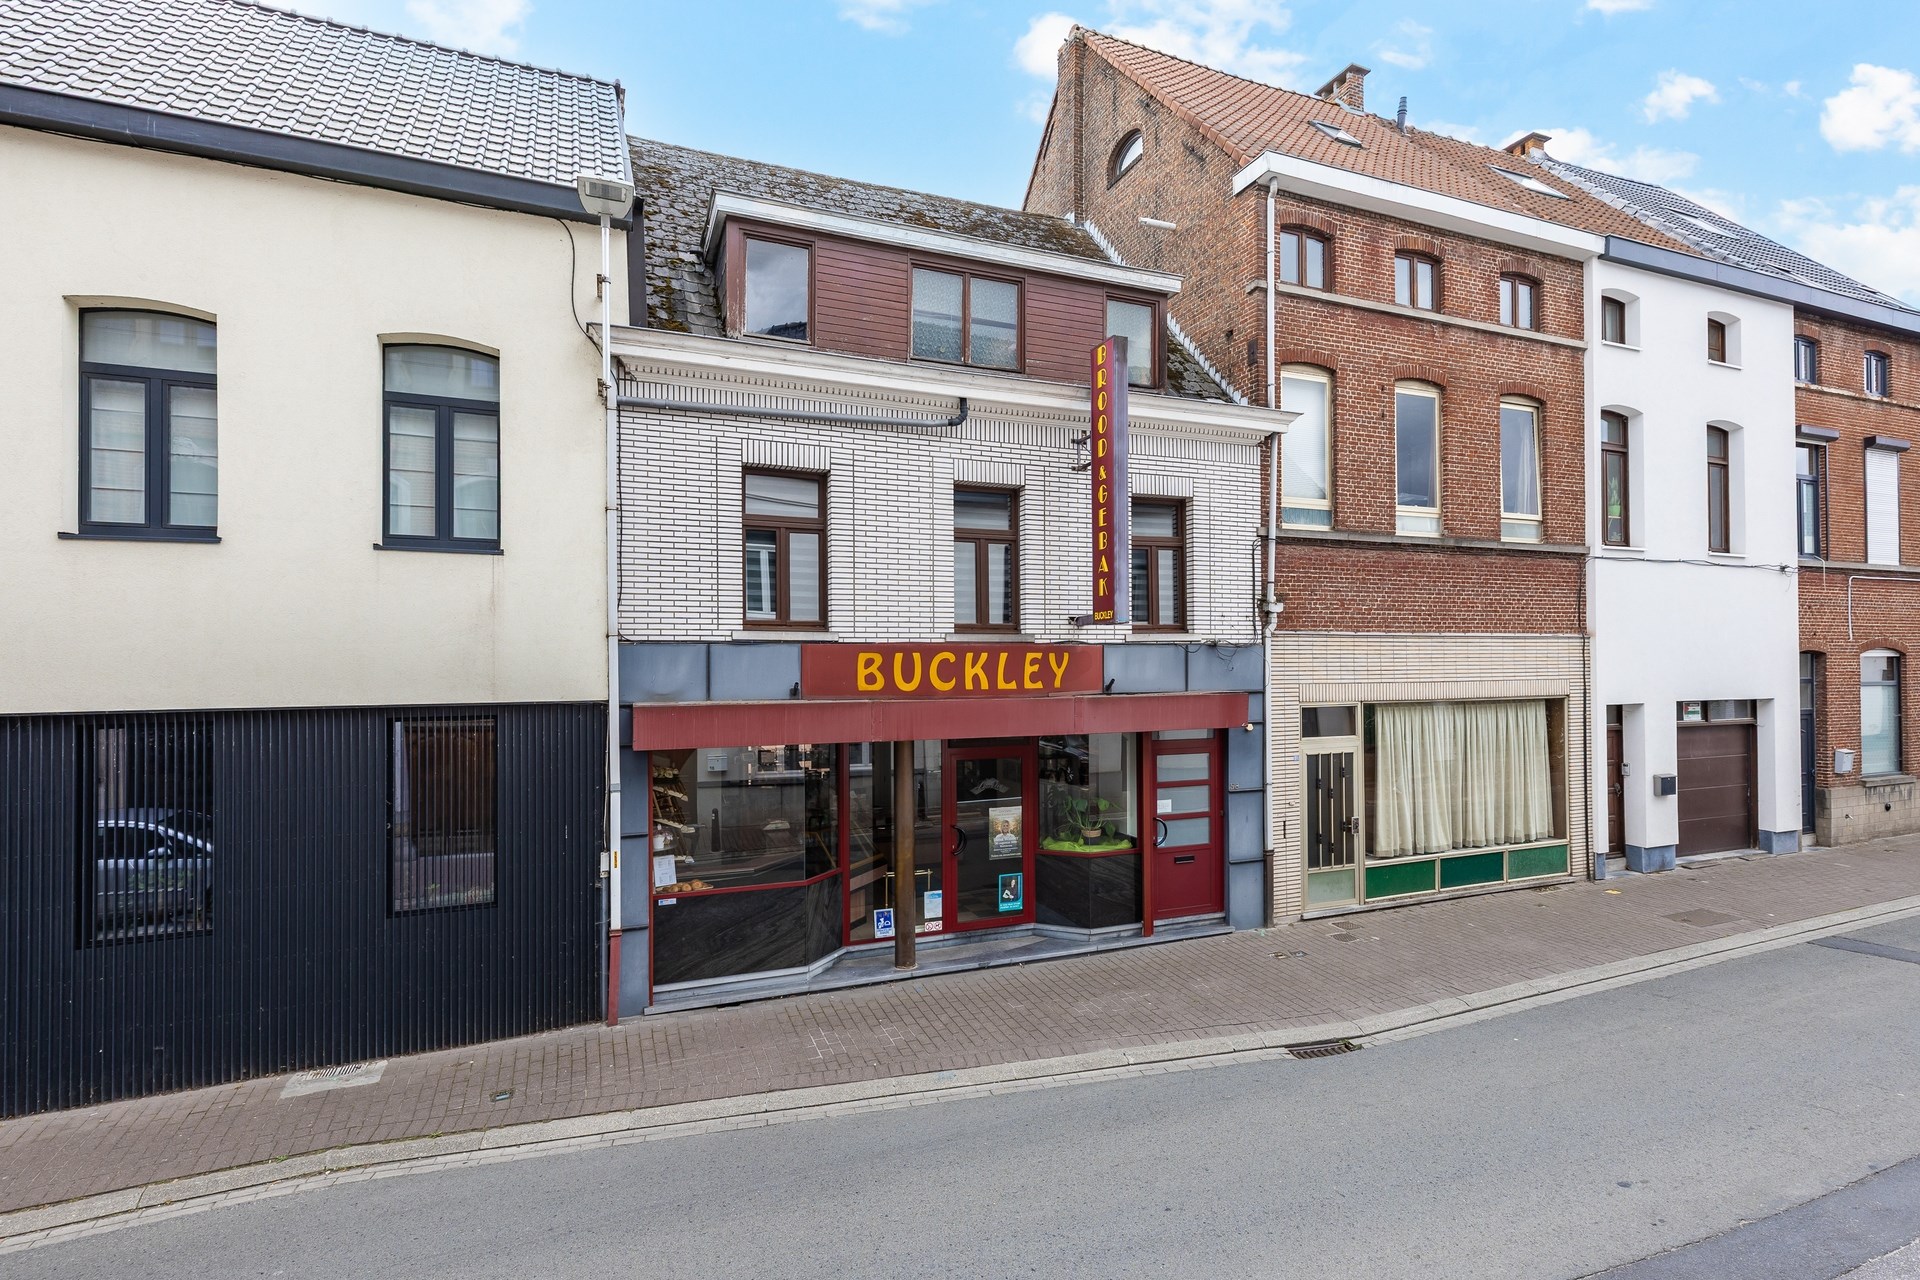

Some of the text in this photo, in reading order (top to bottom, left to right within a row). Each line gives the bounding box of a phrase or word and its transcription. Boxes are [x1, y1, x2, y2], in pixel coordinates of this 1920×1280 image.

[1097, 344, 1109, 597] BROOD & GEBAK
[1094, 610, 1114, 620] BUCKLEY
[856, 651, 1070, 692] BUCKLEY
